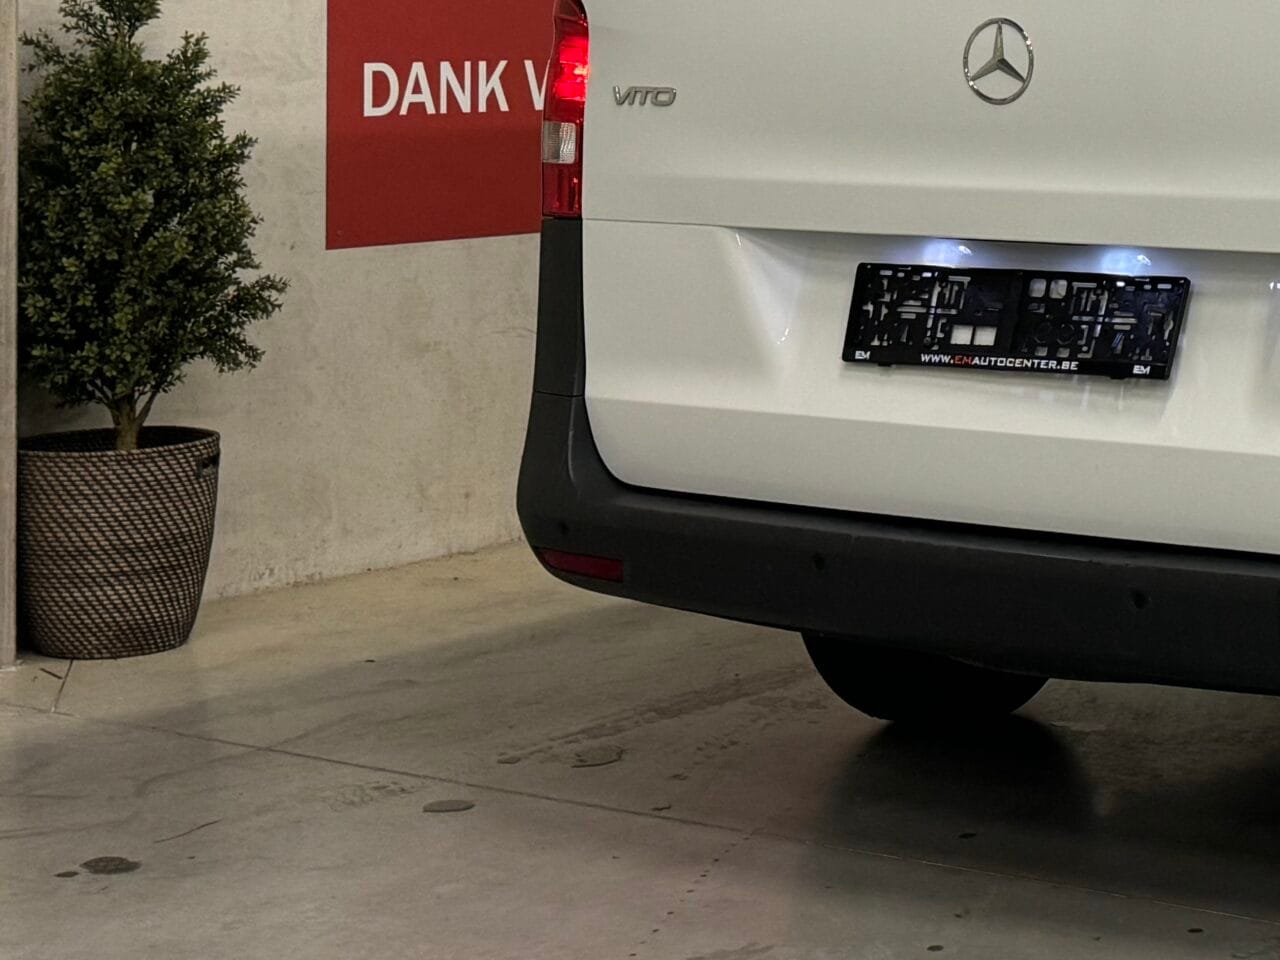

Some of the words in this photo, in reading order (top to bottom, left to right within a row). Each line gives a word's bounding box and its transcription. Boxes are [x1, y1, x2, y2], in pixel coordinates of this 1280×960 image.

[363, 61, 509, 117] DANK
[524, 60, 551, 111] V
[612, 85, 677, 107] VITO
[855, 350, 870, 360] EM
[1132, 364, 1151, 375] EM
